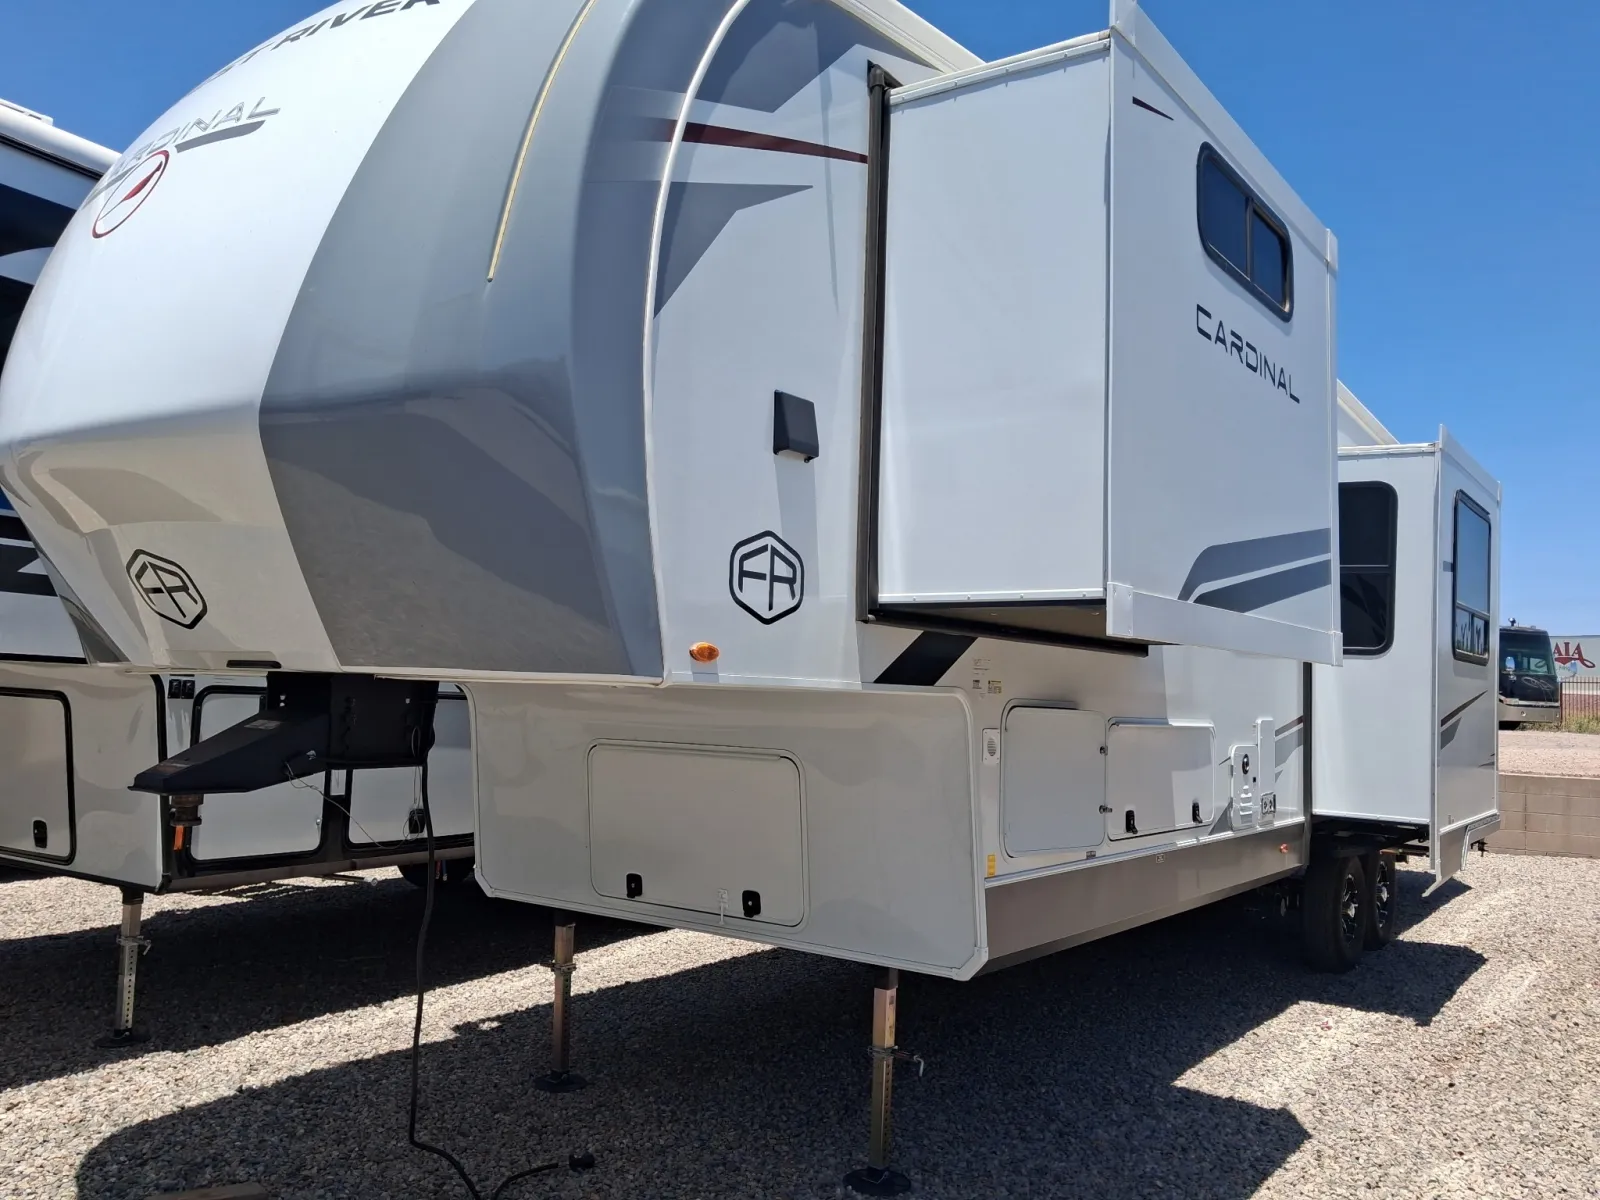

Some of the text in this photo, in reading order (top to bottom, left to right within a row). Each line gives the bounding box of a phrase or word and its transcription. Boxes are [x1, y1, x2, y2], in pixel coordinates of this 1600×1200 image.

[1196, 303, 1300, 404] CARDINAL
[134, 560, 198, 619] FR
[737, 543, 797, 612] FR
